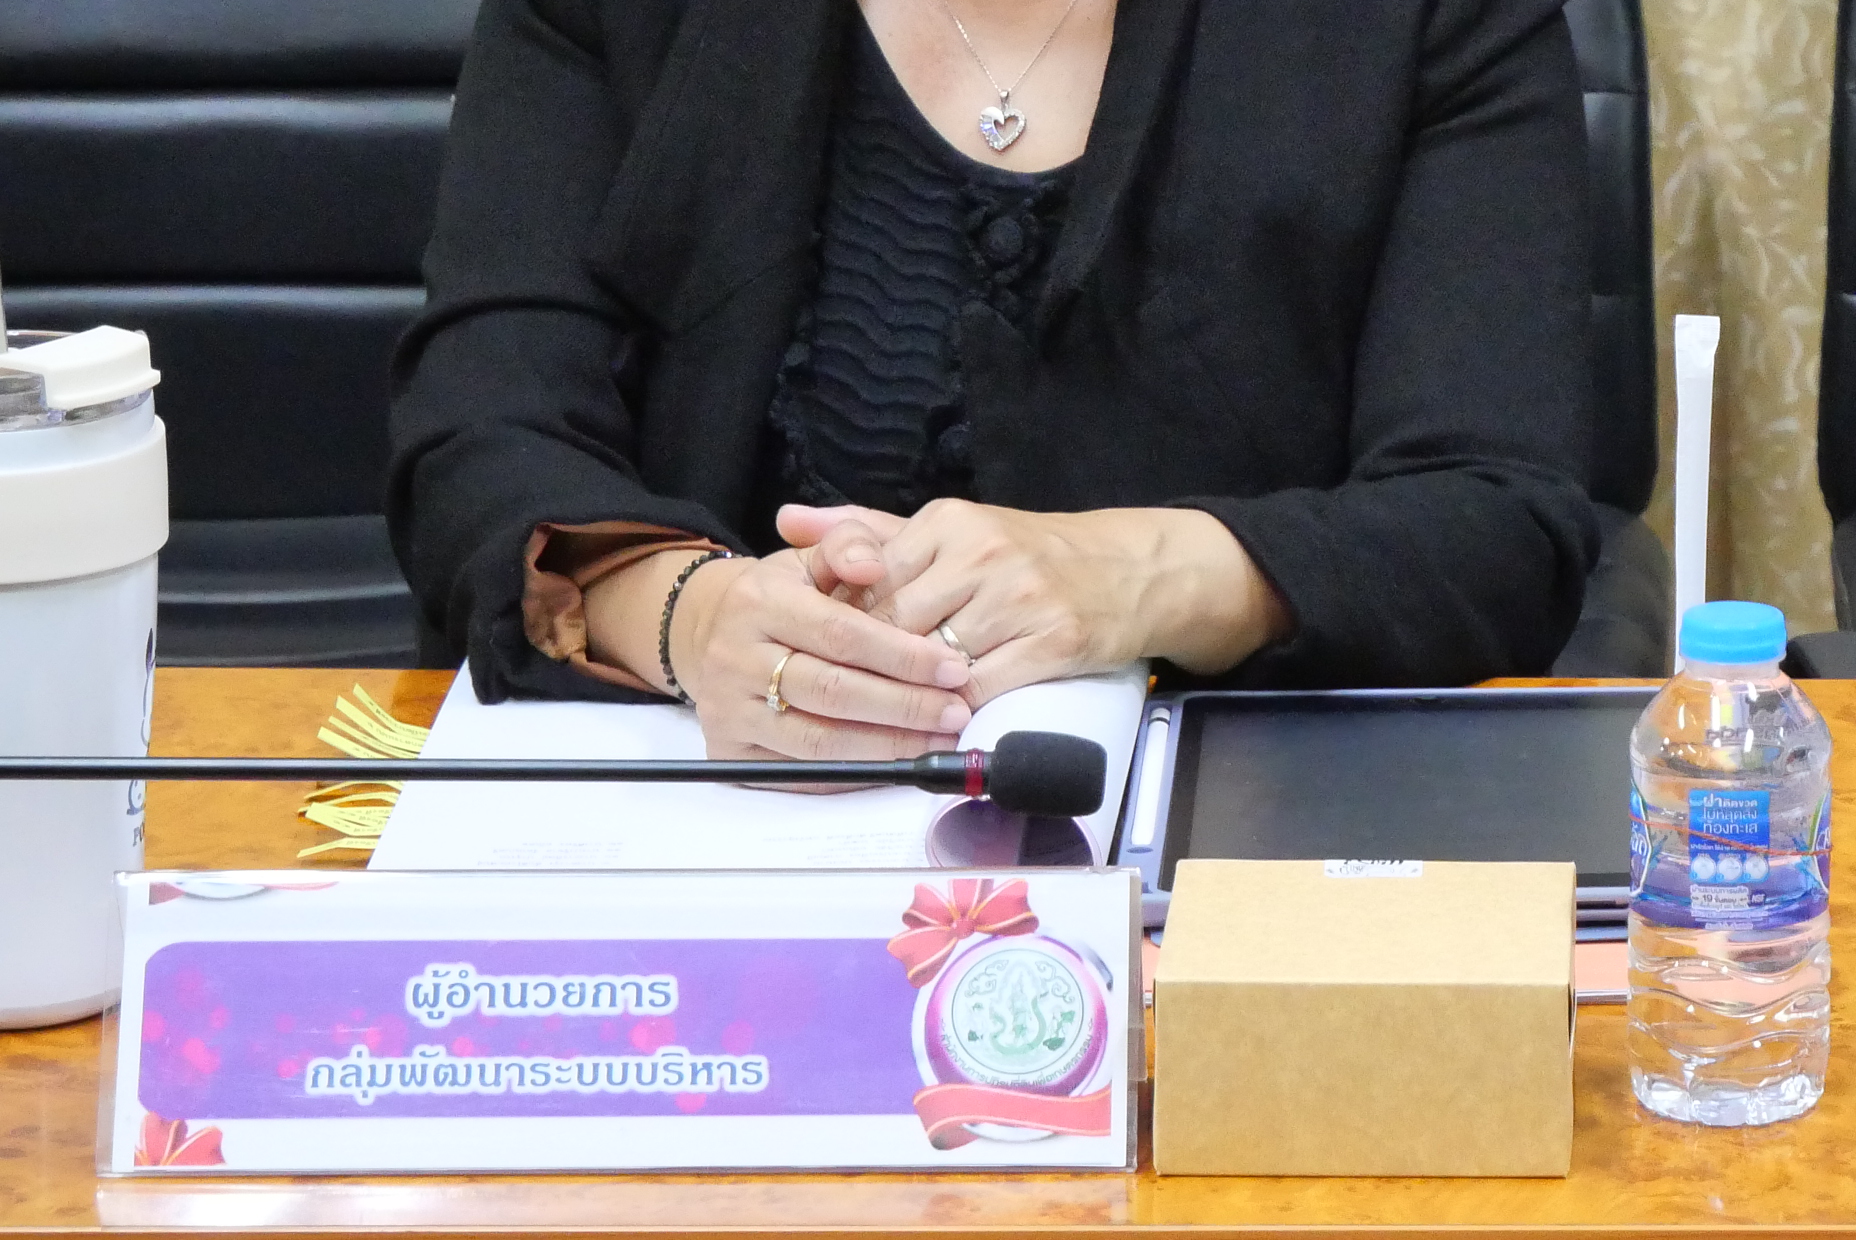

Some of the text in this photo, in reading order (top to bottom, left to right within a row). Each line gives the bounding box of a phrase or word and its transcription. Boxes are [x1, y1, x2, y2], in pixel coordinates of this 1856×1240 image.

[412, 969, 672, 1020] ผู้อำนวยการ
[310, 1049, 764, 1099] กลุ่มพัฒนาระบบบริหาร
